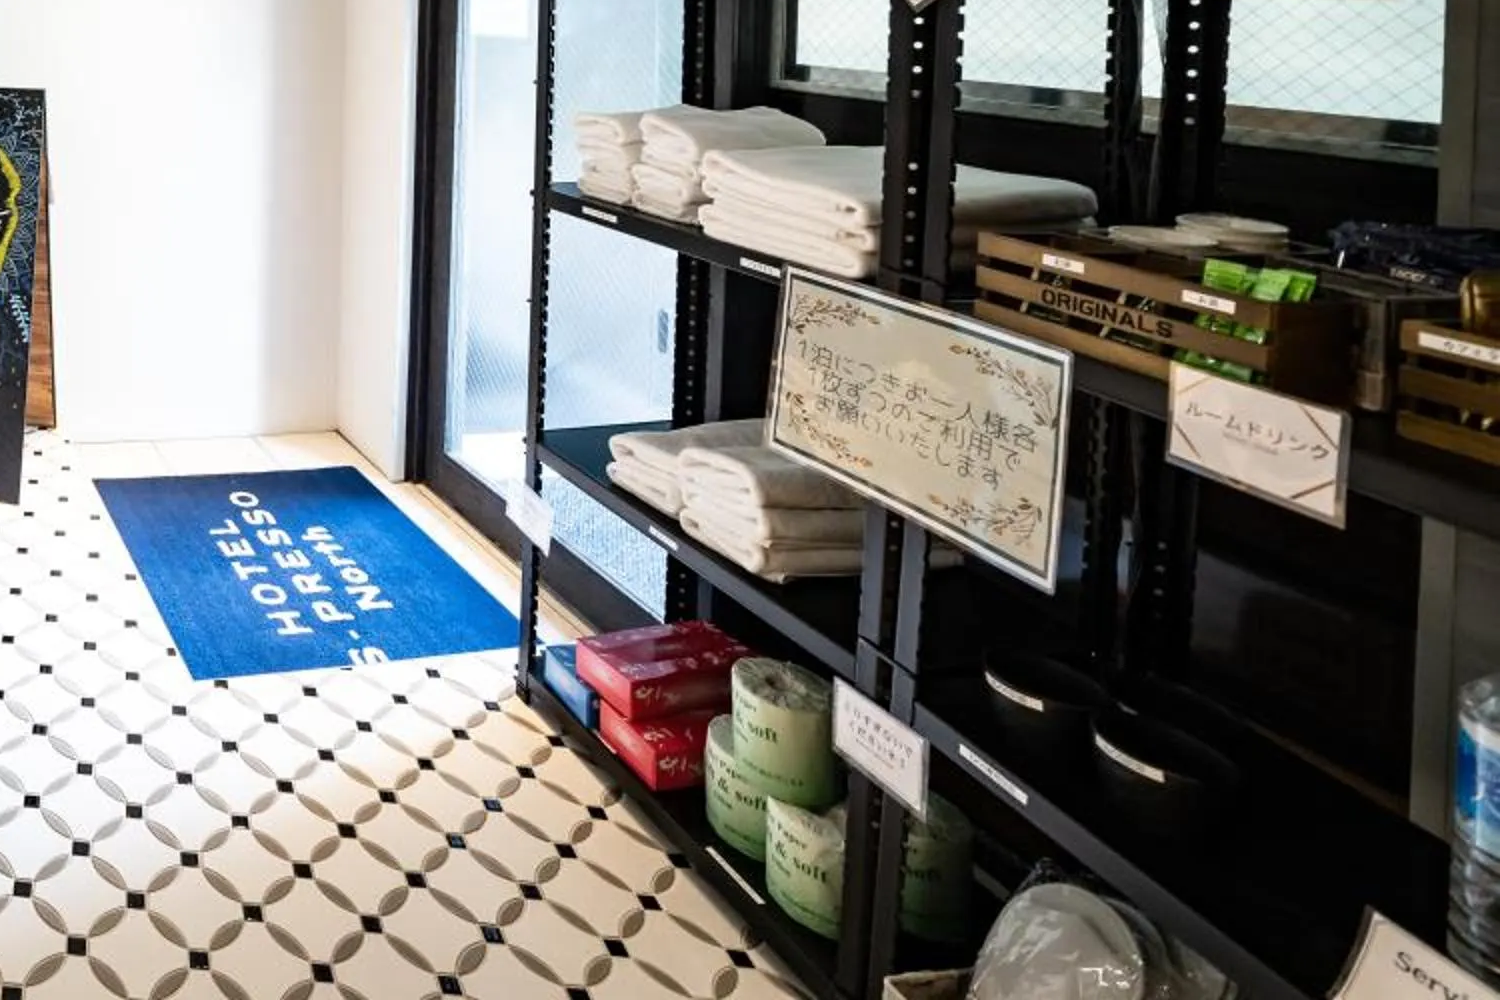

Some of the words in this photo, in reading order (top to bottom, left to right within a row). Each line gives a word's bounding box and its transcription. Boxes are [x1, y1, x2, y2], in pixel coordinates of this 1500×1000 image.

[1041, 288, 1173, 338] ORIGINALS
[1186, 401, 1330, 459] ルームドリンク
[209, 519, 315, 636] HOTEL
[301, 526, 395, 612] North
[1394, 951, 1470, 1000] Serv
